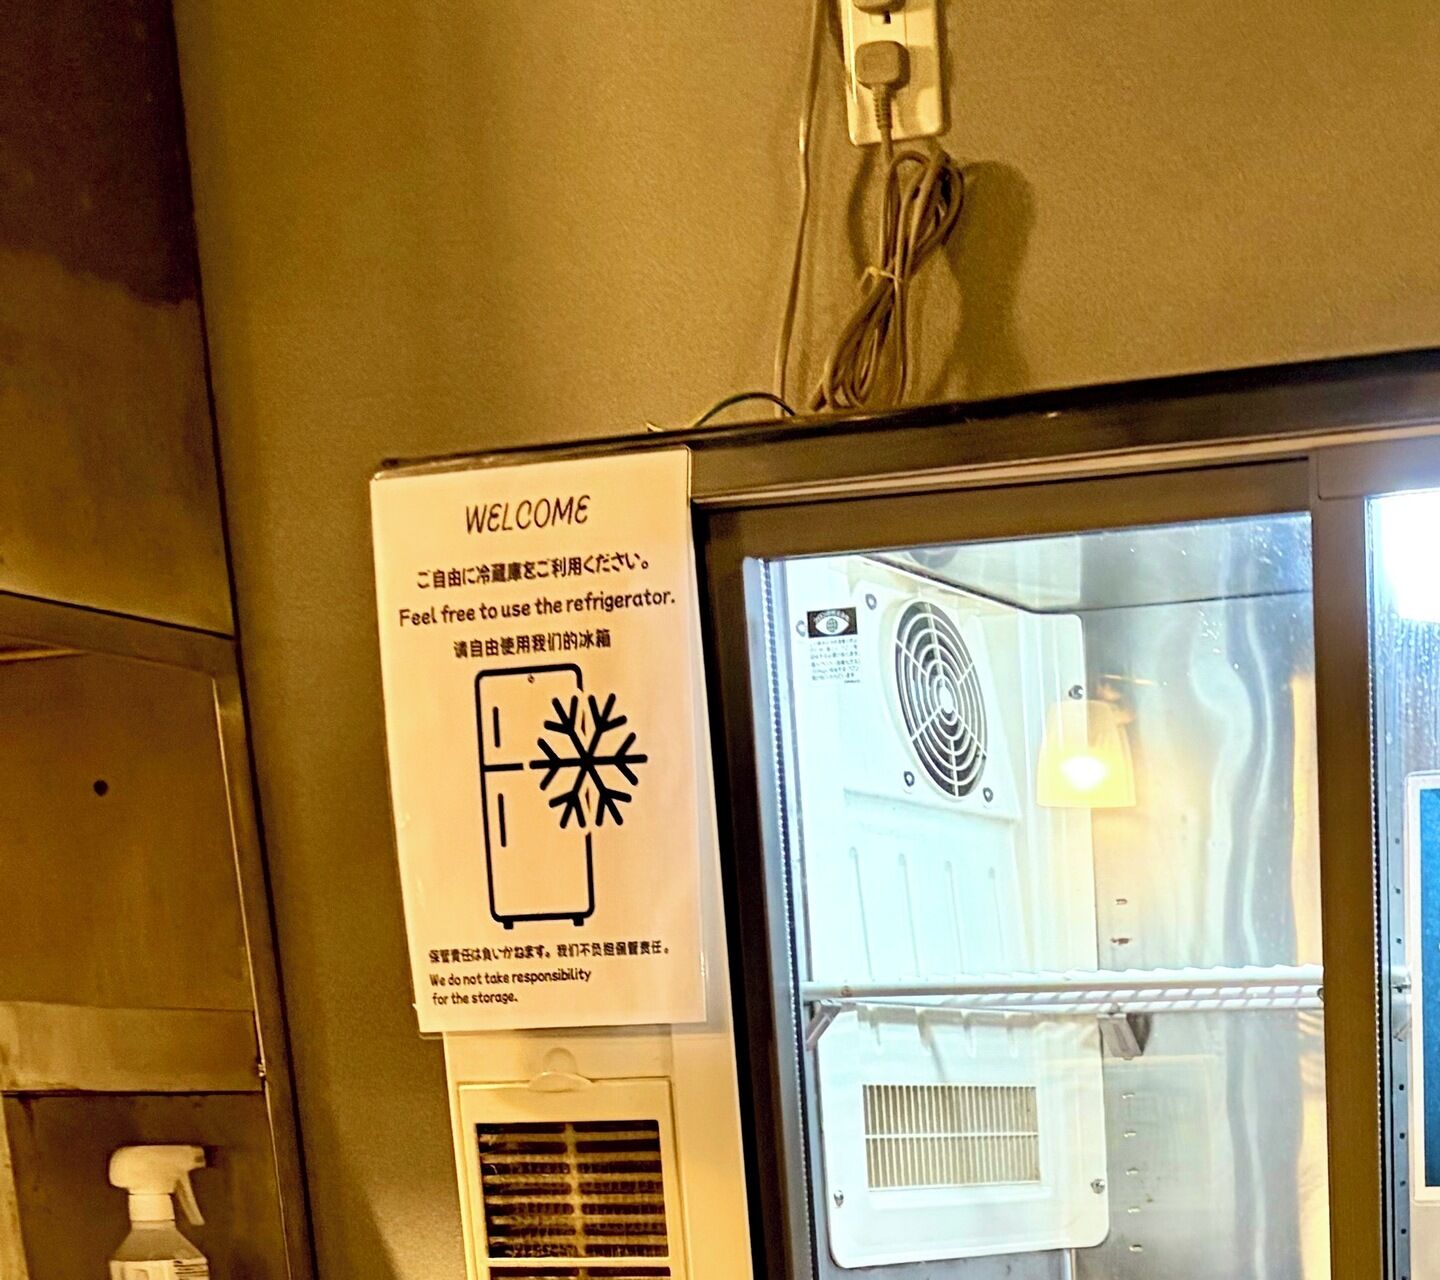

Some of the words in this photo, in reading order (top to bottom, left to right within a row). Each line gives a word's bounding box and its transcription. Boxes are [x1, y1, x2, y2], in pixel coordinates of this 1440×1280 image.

[465, 494, 591, 534] WELCOME
[417, 552, 649, 589] ご自由に冷蔵庫をご利用ください。
[398, 606, 437, 626] Feel
[440, 604, 475, 623] free
[478, 602, 498, 620] to
[500, 602, 531, 618] use
[533, 596, 563, 615] the
[565, 589, 675, 613] refrigerator.
[429, 974, 445, 986] We
[447, 972, 461, 986] do
[462, 973, 482, 985] not
[483, 971, 509, 984] take
[511, 967, 592, 985] responsibility
[431, 992, 448, 1005] for
[450, 991, 469, 1004] the
[471, 992, 518, 1005] storage.
